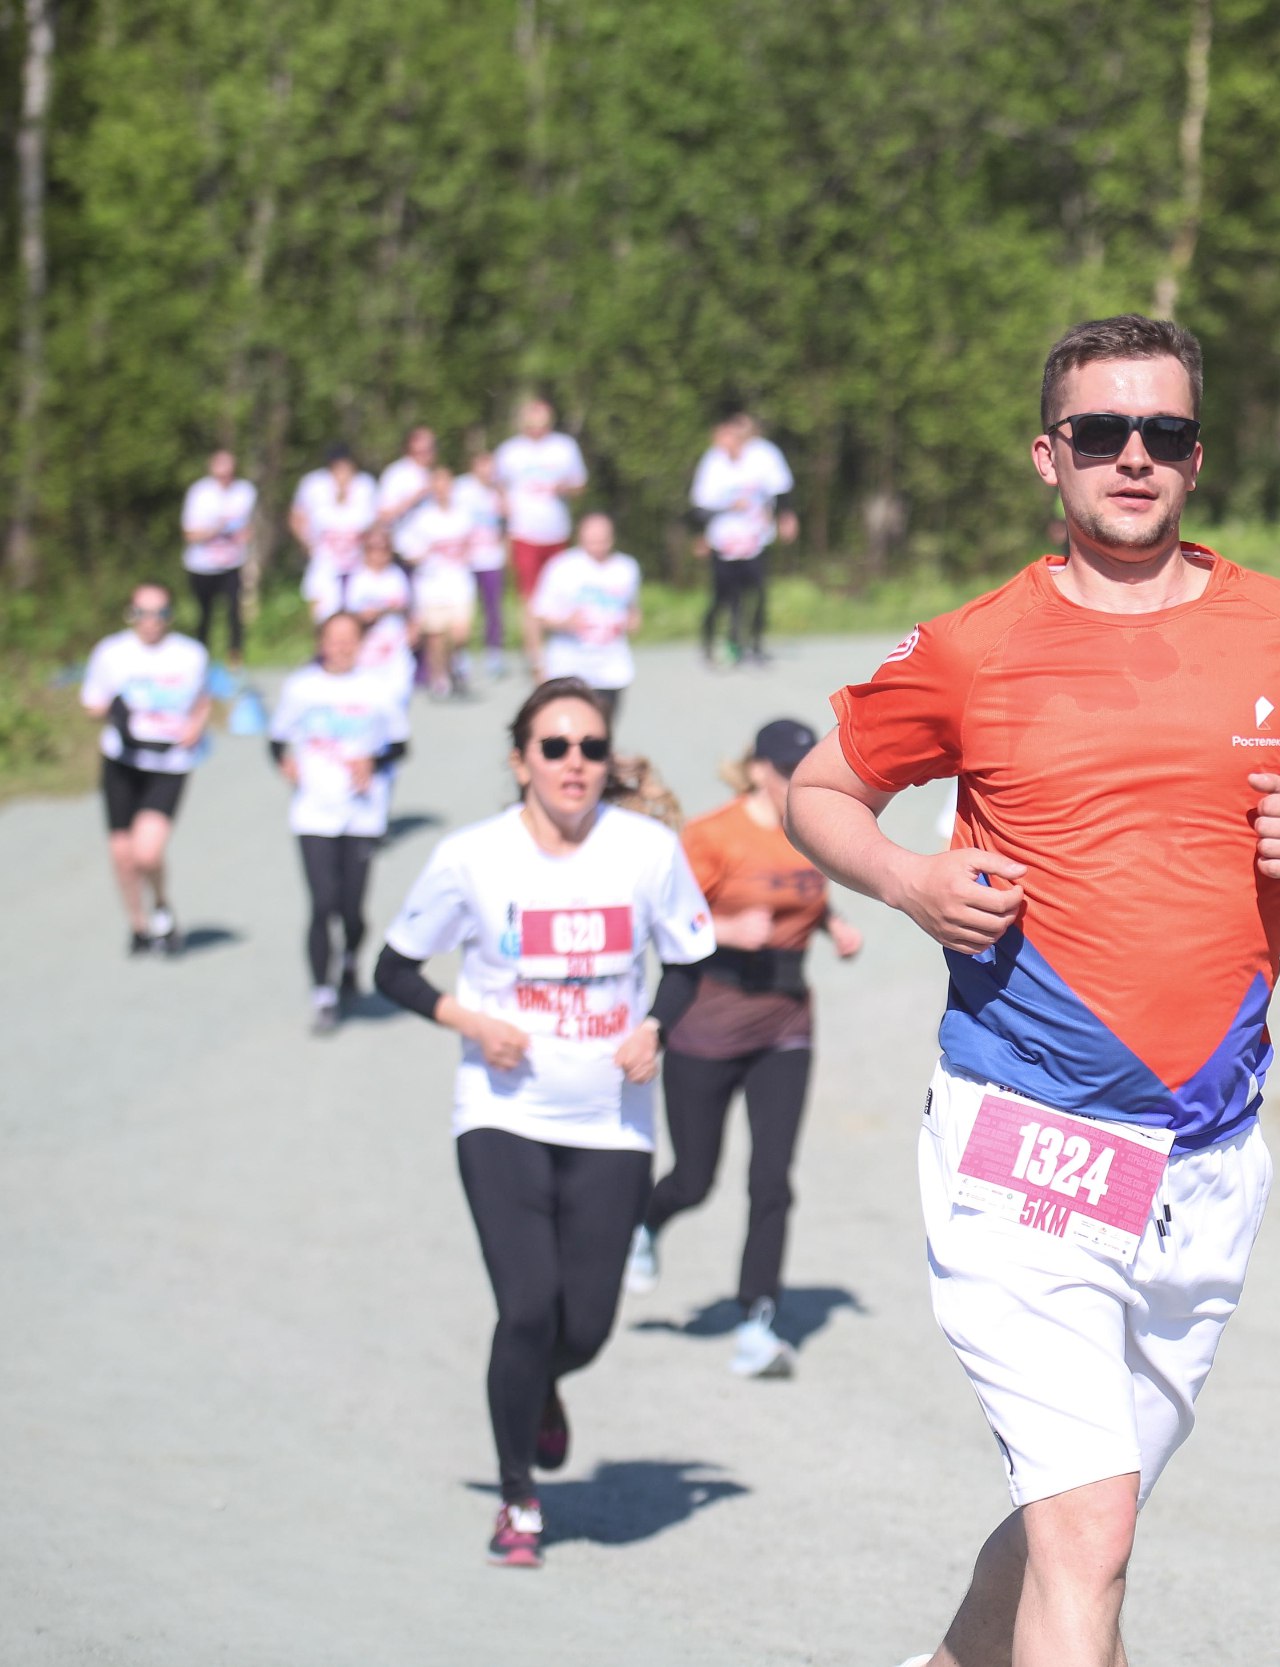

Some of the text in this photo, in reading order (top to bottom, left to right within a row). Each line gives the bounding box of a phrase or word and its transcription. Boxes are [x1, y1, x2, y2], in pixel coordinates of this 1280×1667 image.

[552, 911, 606, 954] 620
[1011, 1122, 1115, 1206] 1324
[1019, 1196, 1072, 1238] 5KM
